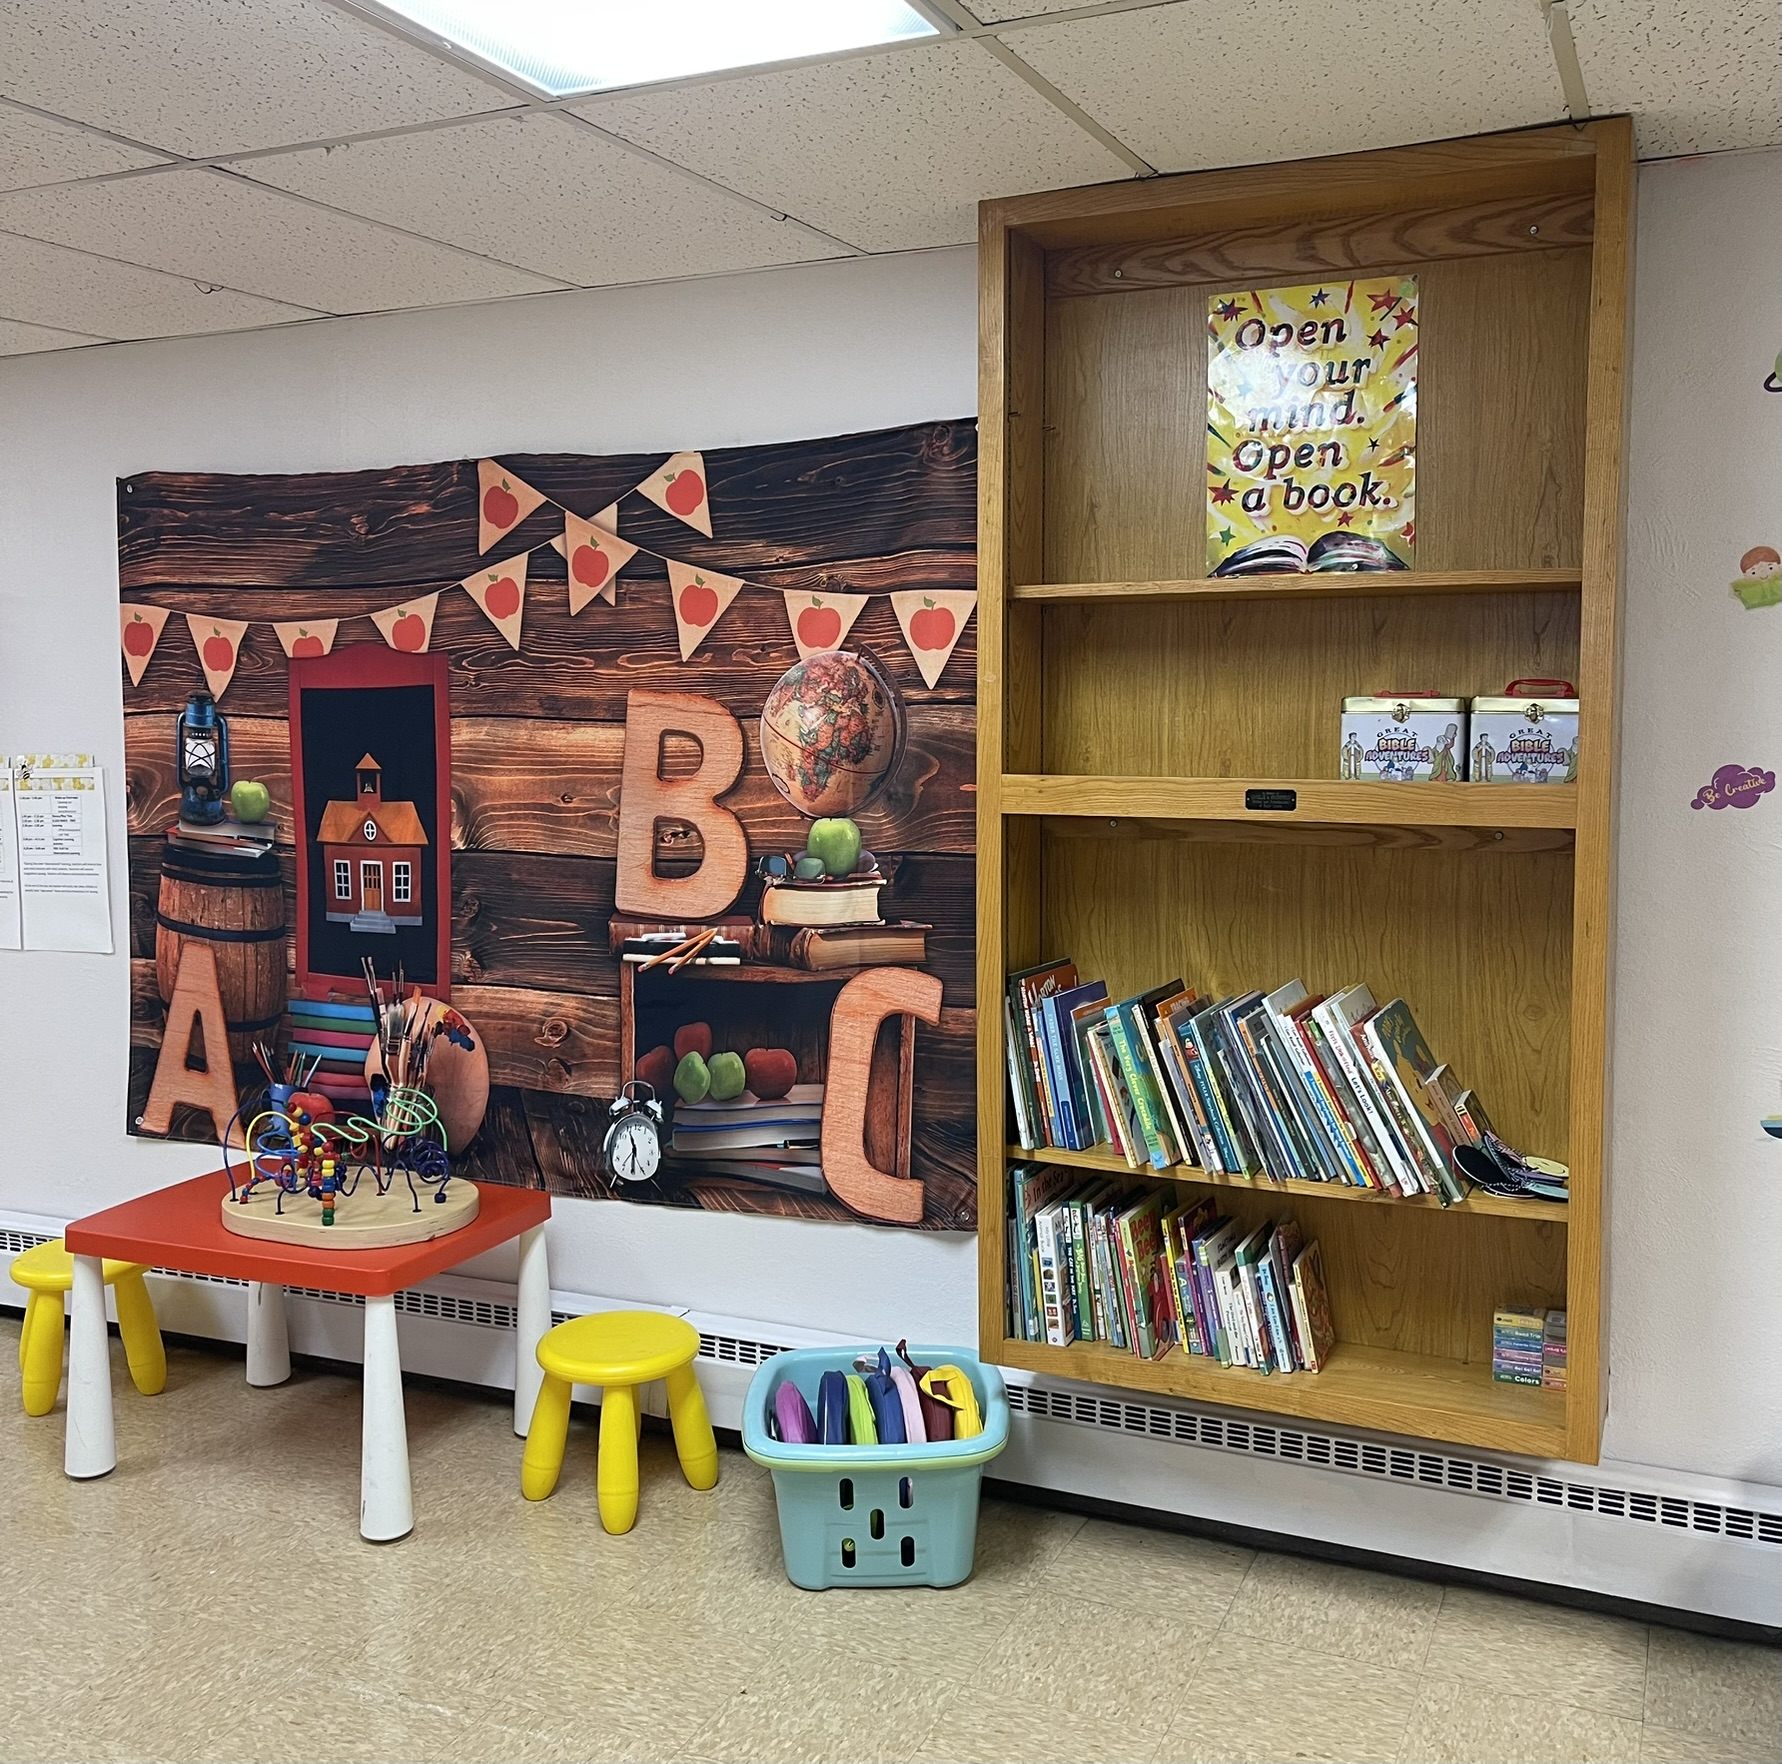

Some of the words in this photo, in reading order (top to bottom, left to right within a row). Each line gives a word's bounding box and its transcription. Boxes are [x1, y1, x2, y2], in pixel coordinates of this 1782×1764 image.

[1235, 317, 1347, 358] Open
[1277, 357, 1371, 399] your
[1249, 389, 1365, 432] mind.
[1232, 439, 1342, 480] Open
[1241, 485, 1266, 513] a
[1283, 472, 1391, 510] book.
[1377, 726, 1418, 738] GREAT
[1378, 737, 1416, 751] BIBLE
[1510, 727, 1553, 739] GREAT
[1510, 739, 1551, 753] BIBLE
[1365, 750, 1430, 763] ADVENTURES
[1496, 751, 1565, 765] ADVENTURES
[614, 688, 749, 921] B
[1703, 788, 1721, 803] Be
[1725, 778, 1767, 796] Creative
[140, 941, 248, 1149] A
[820, 966, 944, 1224] C
[1119, 1041, 1127, 1054] The
[1123, 1056, 1133, 1072] Very
[1130, 1074, 1140, 1096] Clever
[1138, 1098, 1151, 1130] Crocodile
[1352, 1077, 1362, 1094] Let's
[1361, 1095, 1373, 1115] Look!
[1514, 1375, 1540, 1385] Colors
